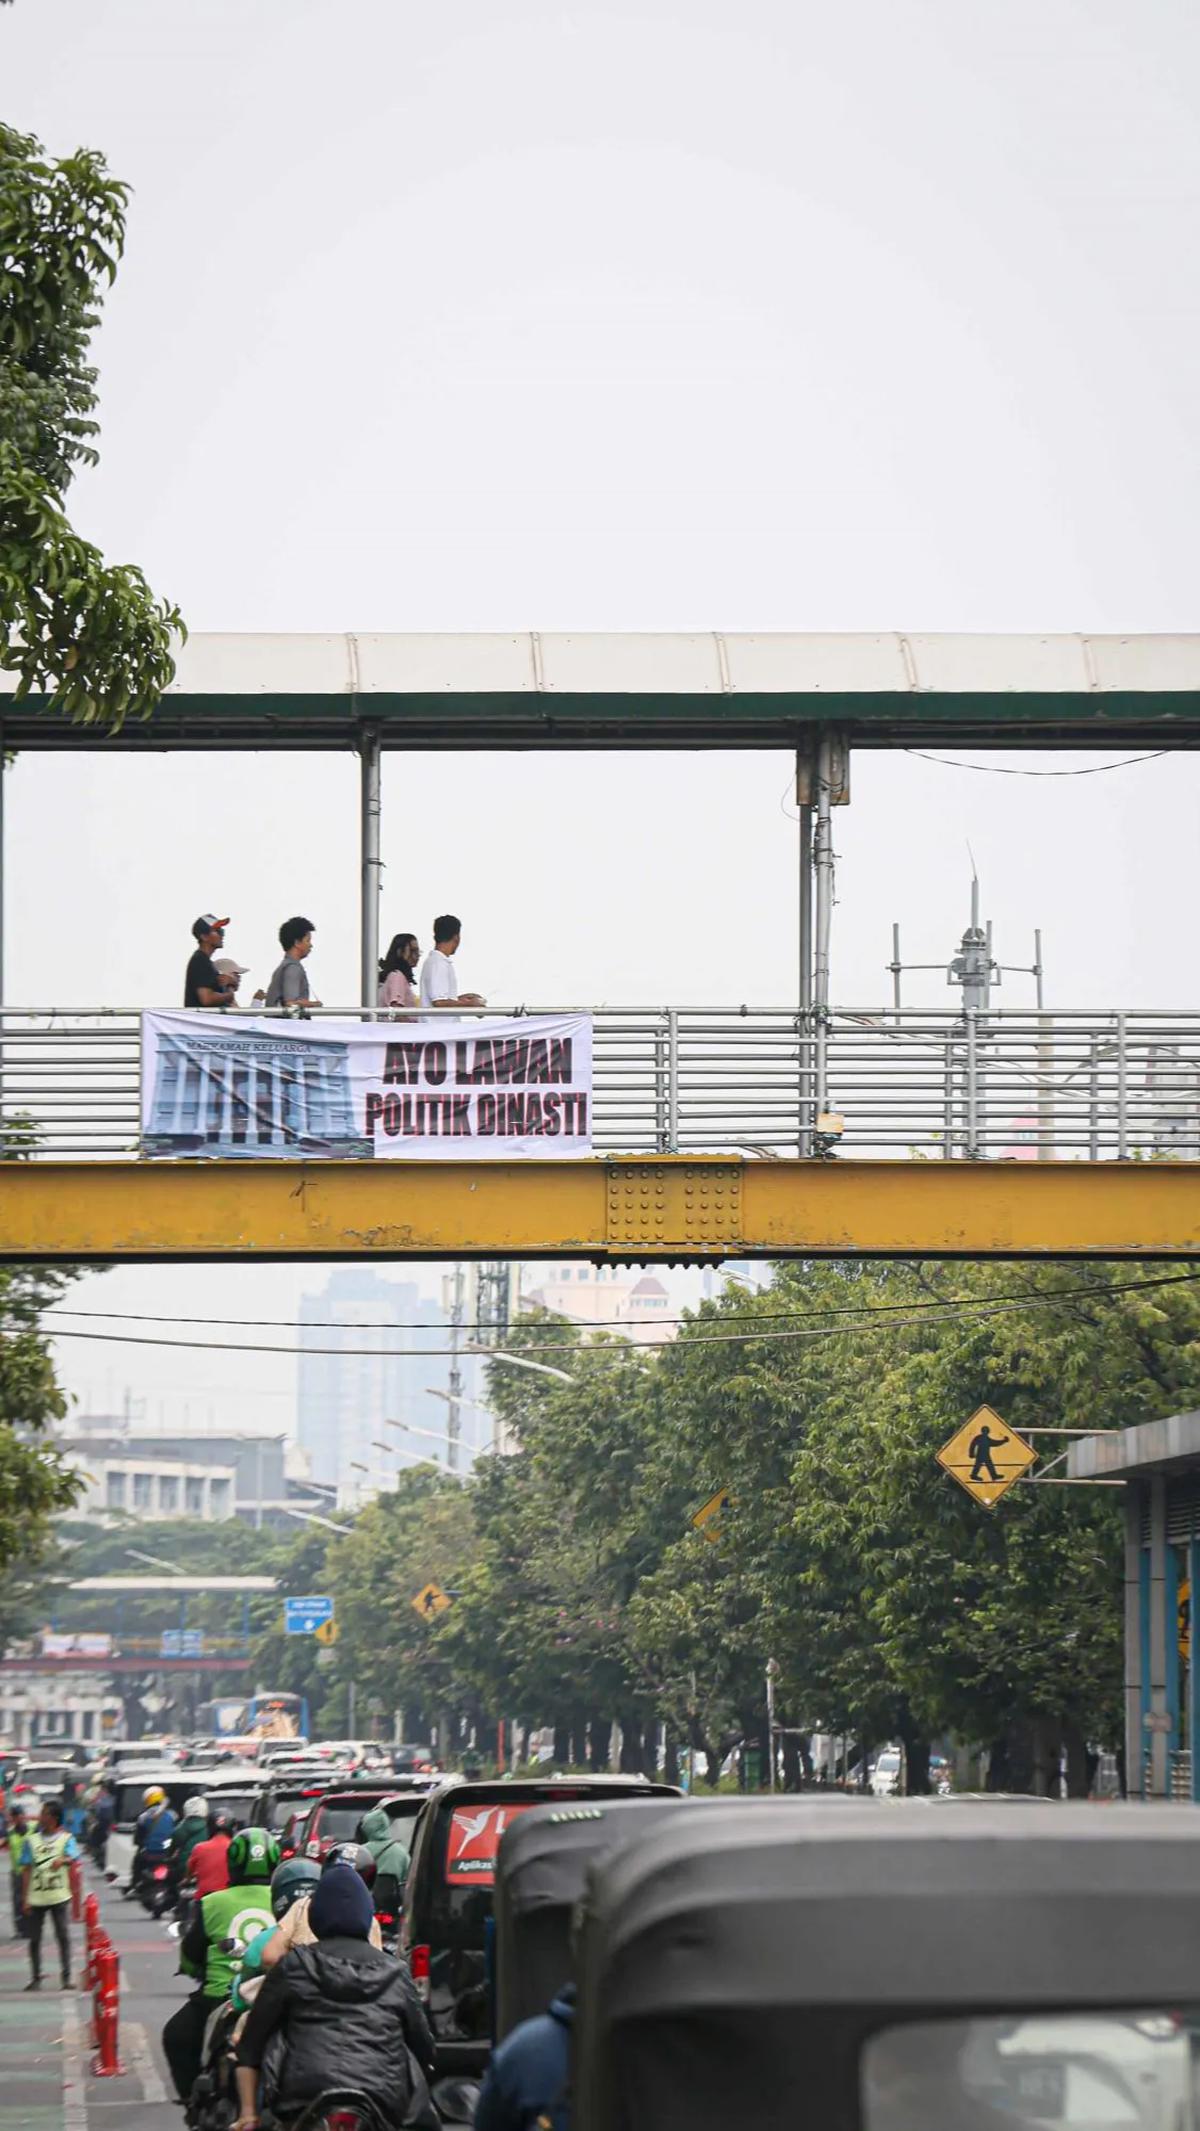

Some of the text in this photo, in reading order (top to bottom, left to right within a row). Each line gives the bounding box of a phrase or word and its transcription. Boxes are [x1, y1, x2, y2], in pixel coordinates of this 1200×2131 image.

[253, 1043, 312, 1053] KELUARGA
[382, 1037, 573, 1086] AYO LAWAN
[365, 1091, 588, 1136] POLITIK DINASTI
[457, 1859, 496, 1871] Aplikas
